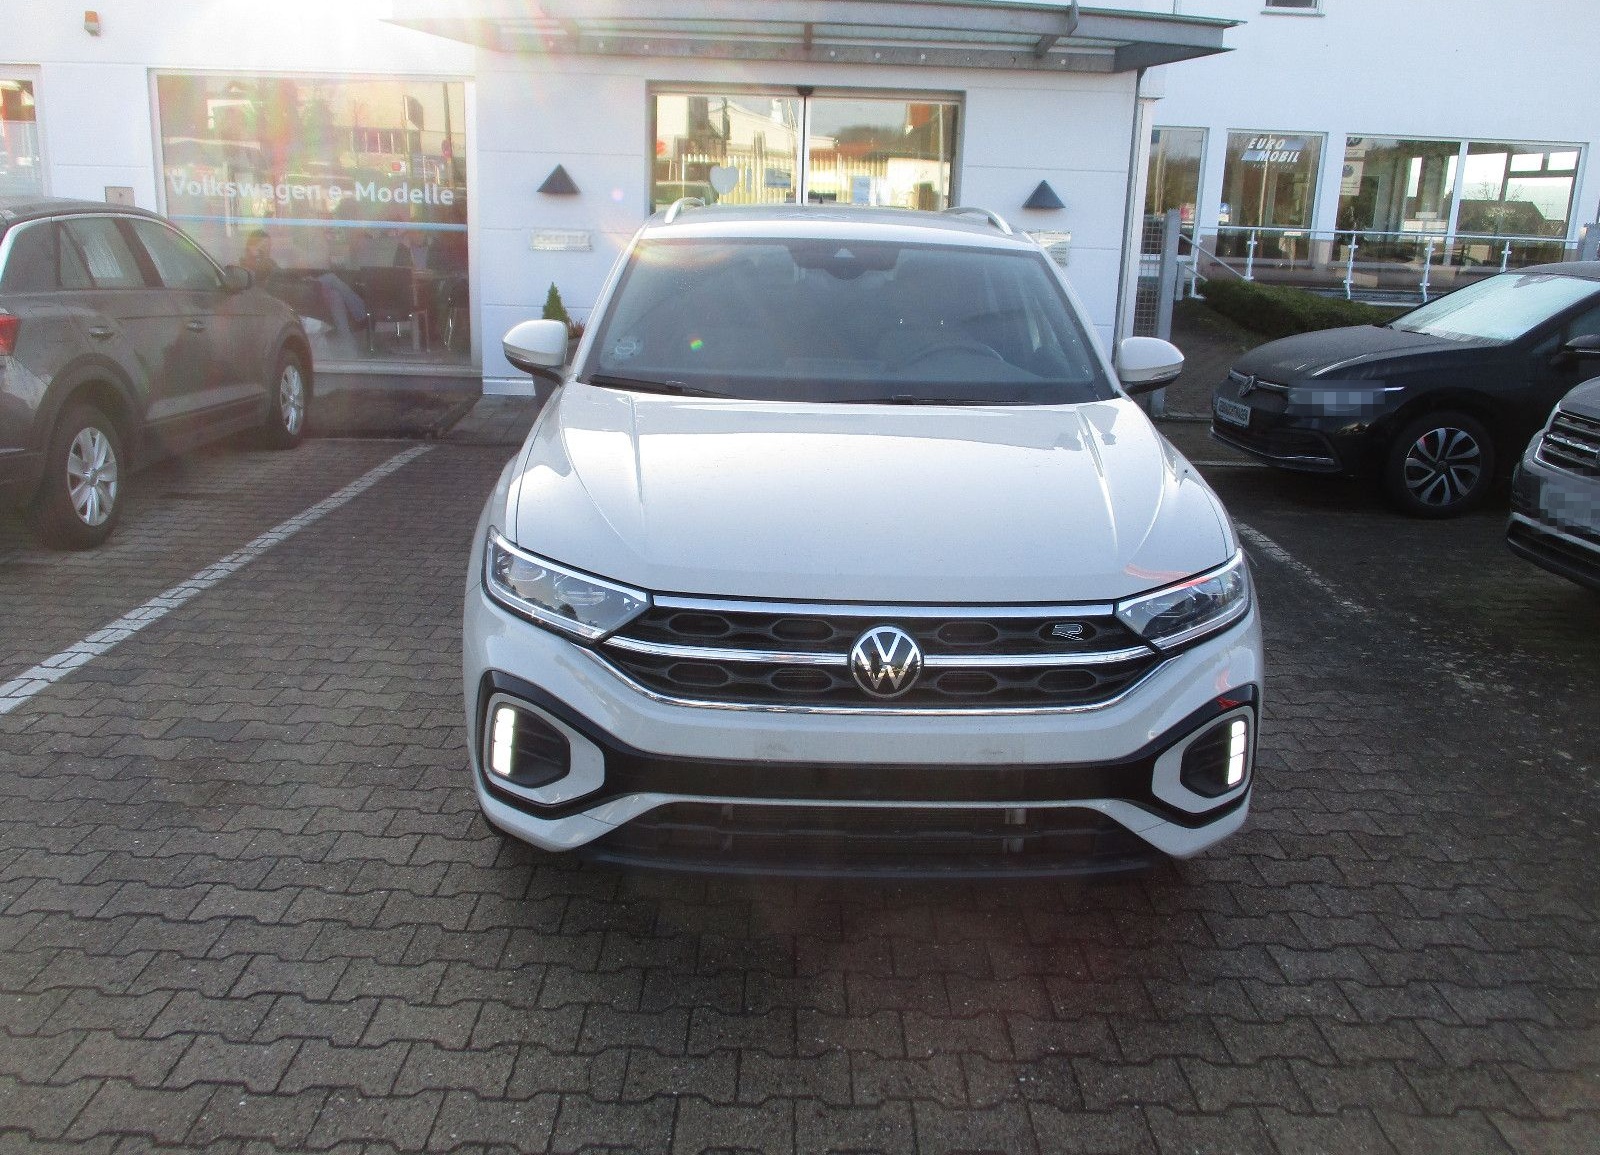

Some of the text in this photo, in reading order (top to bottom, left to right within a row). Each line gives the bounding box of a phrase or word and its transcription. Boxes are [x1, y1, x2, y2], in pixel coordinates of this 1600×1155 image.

[1247, 137, 1286, 150] EURO
[1257, 150, 1301, 163] MOBIL
[168, 169, 454, 205] Volkswagen e-Modelle
